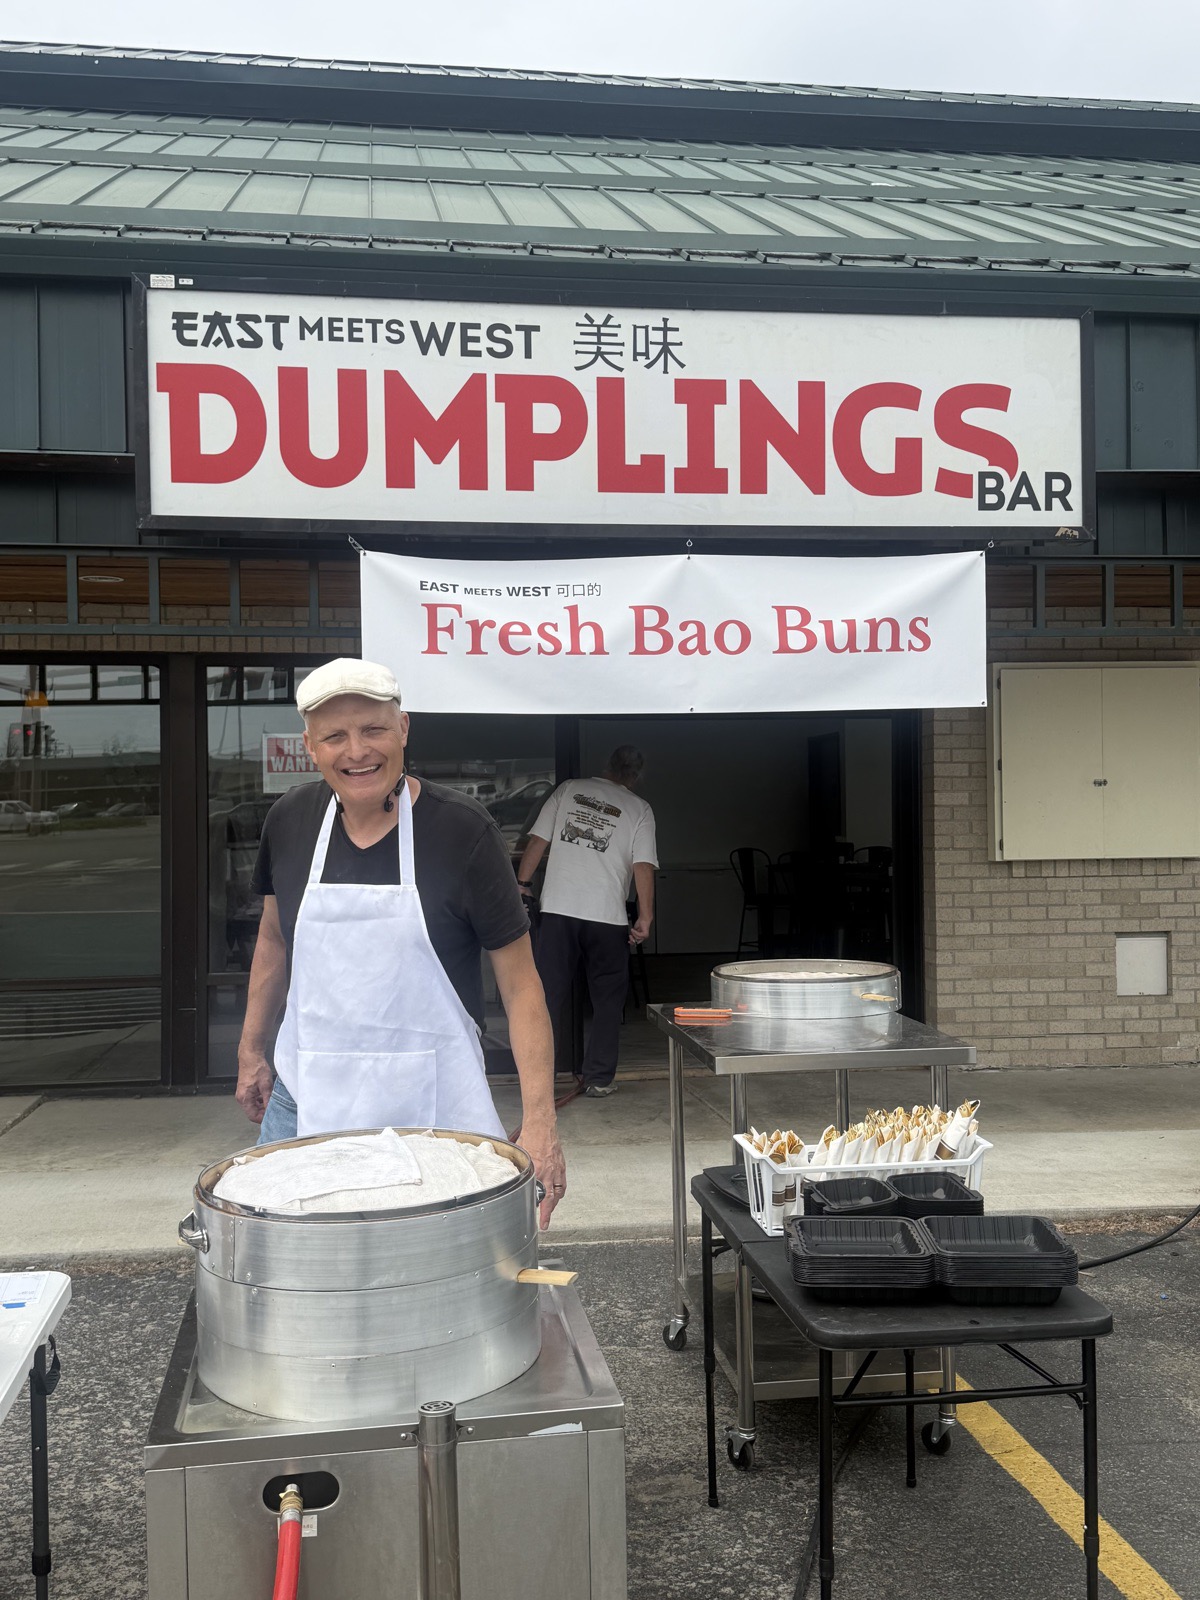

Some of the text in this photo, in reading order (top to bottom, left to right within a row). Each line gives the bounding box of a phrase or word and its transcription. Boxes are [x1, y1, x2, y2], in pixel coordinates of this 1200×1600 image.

[172, 311, 541, 359] EAST MEETS WEST
[573, 313, 687, 375] 美味
[156, 362, 1019, 499] DUMPLINGS
[977, 471, 1074, 512] BAR
[419, 580, 552, 597] EAST MEETS WEST
[556, 582, 602, 598] 可口的
[420, 603, 932, 657] Fresh Bao Buns
[283, 739, 309, 756] HE
